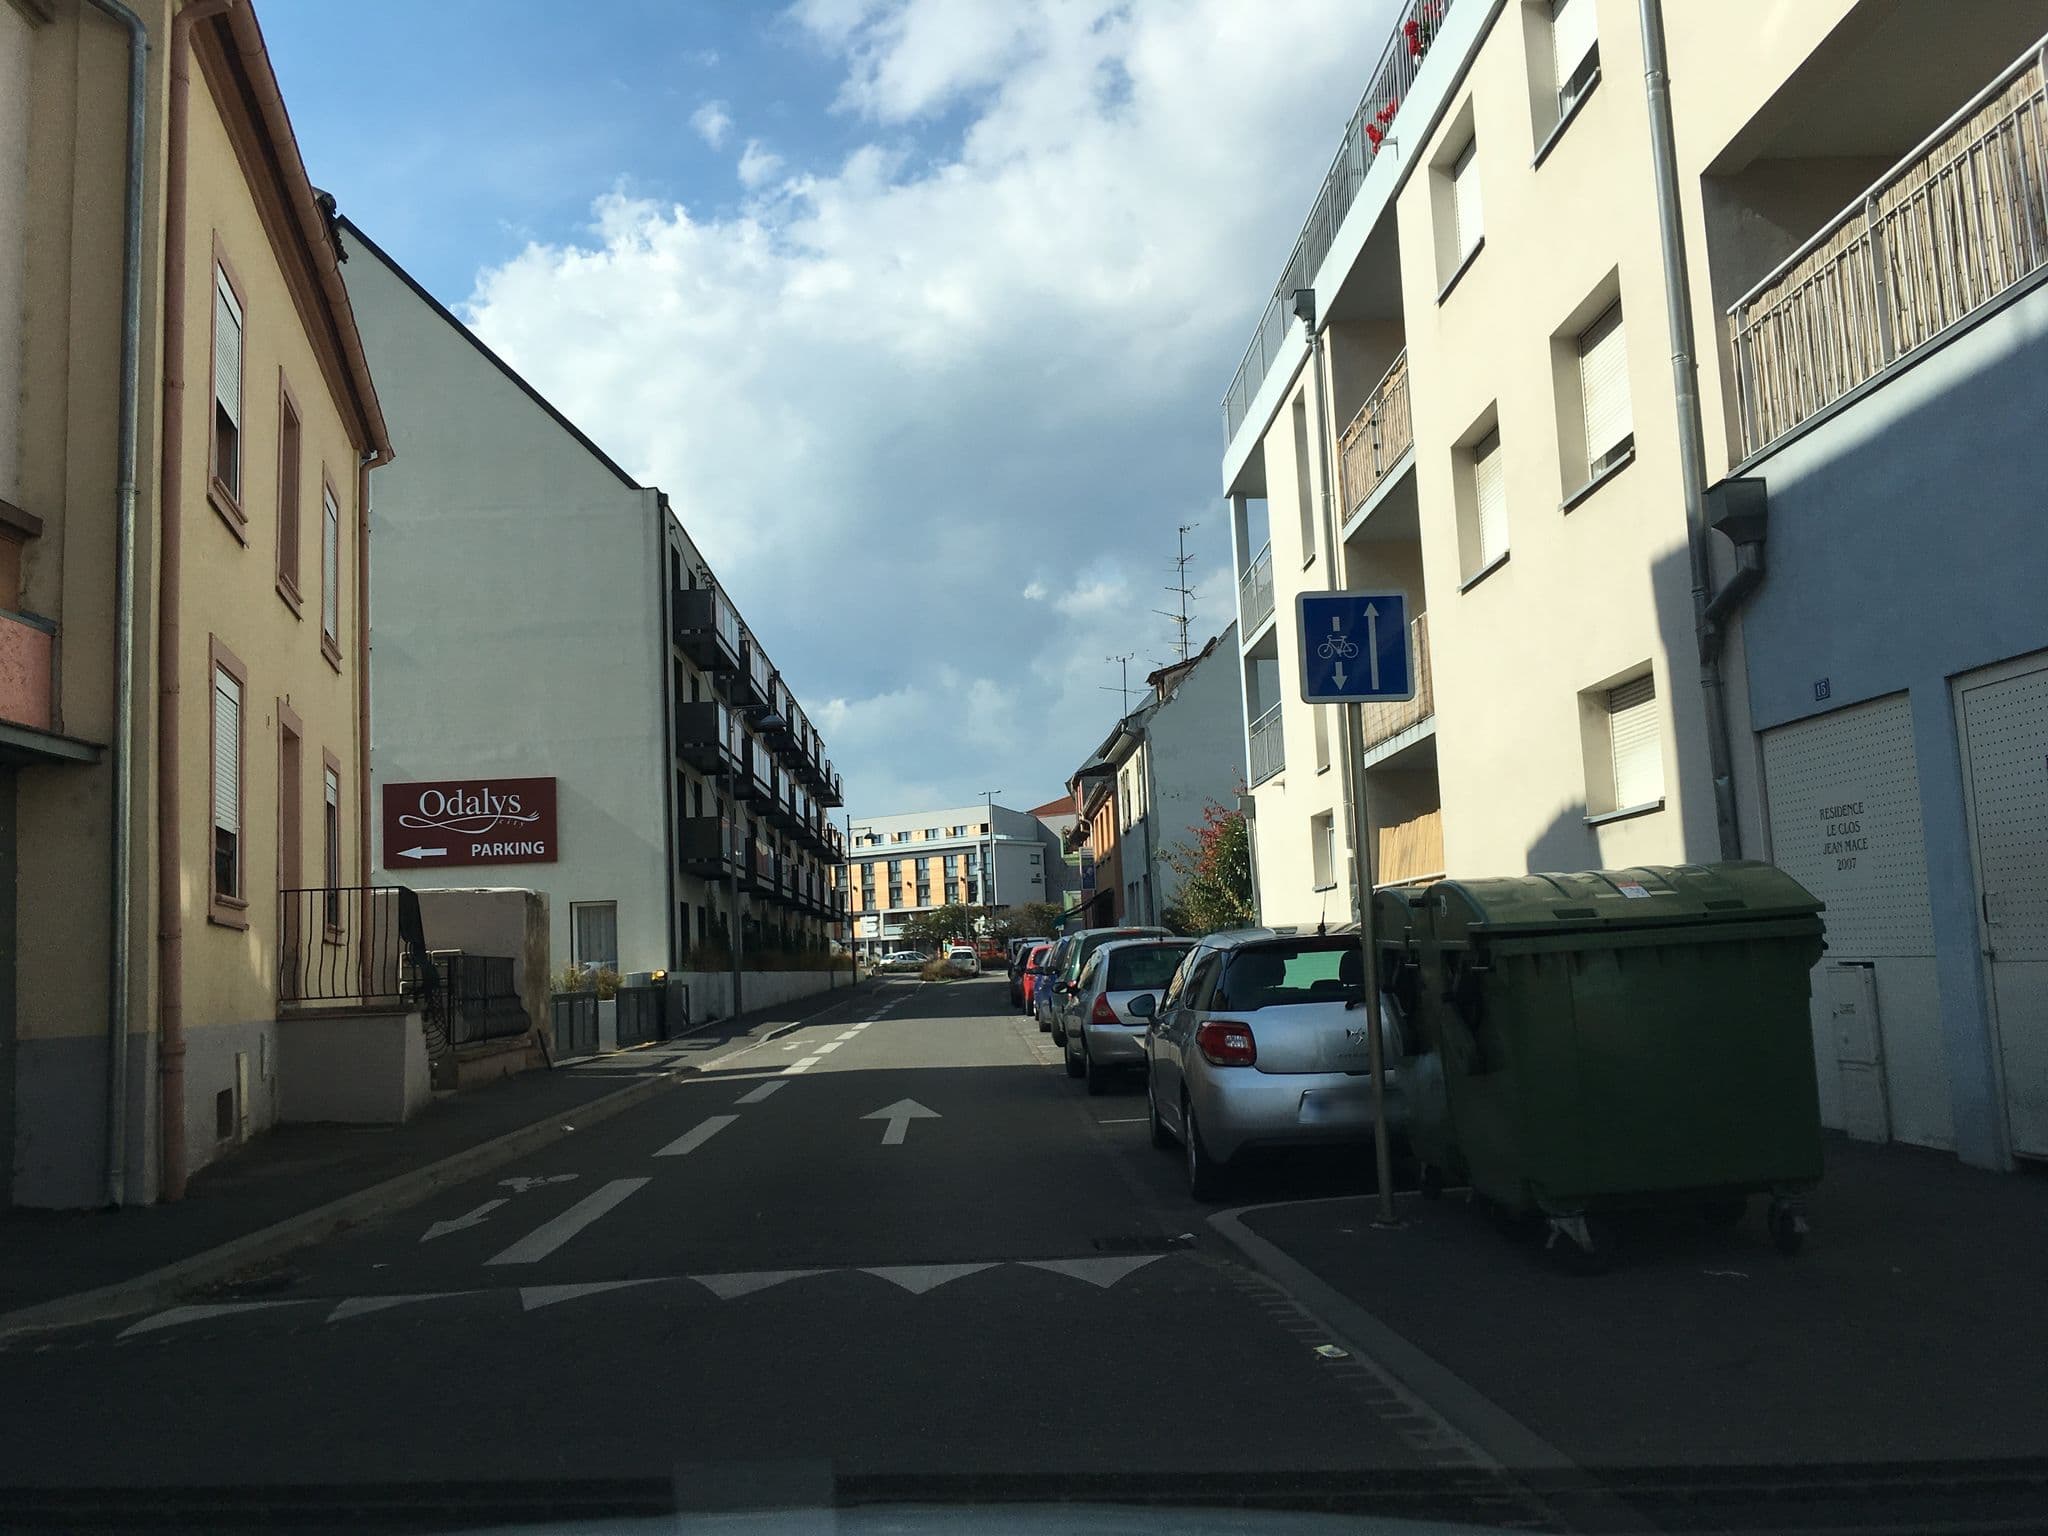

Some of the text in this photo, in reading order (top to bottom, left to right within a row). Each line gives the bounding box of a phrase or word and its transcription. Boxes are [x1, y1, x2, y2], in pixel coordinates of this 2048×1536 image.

[418, 787, 522, 824] Odalys
[1820, 802, 1864, 820] RESIDENCE
[1826, 820, 1861, 837] LE CLOS
[471, 841, 545, 857] PARKING
[1823, 838, 1868, 855] JEAN MACE
[1836, 857, 1857, 871] 2007
